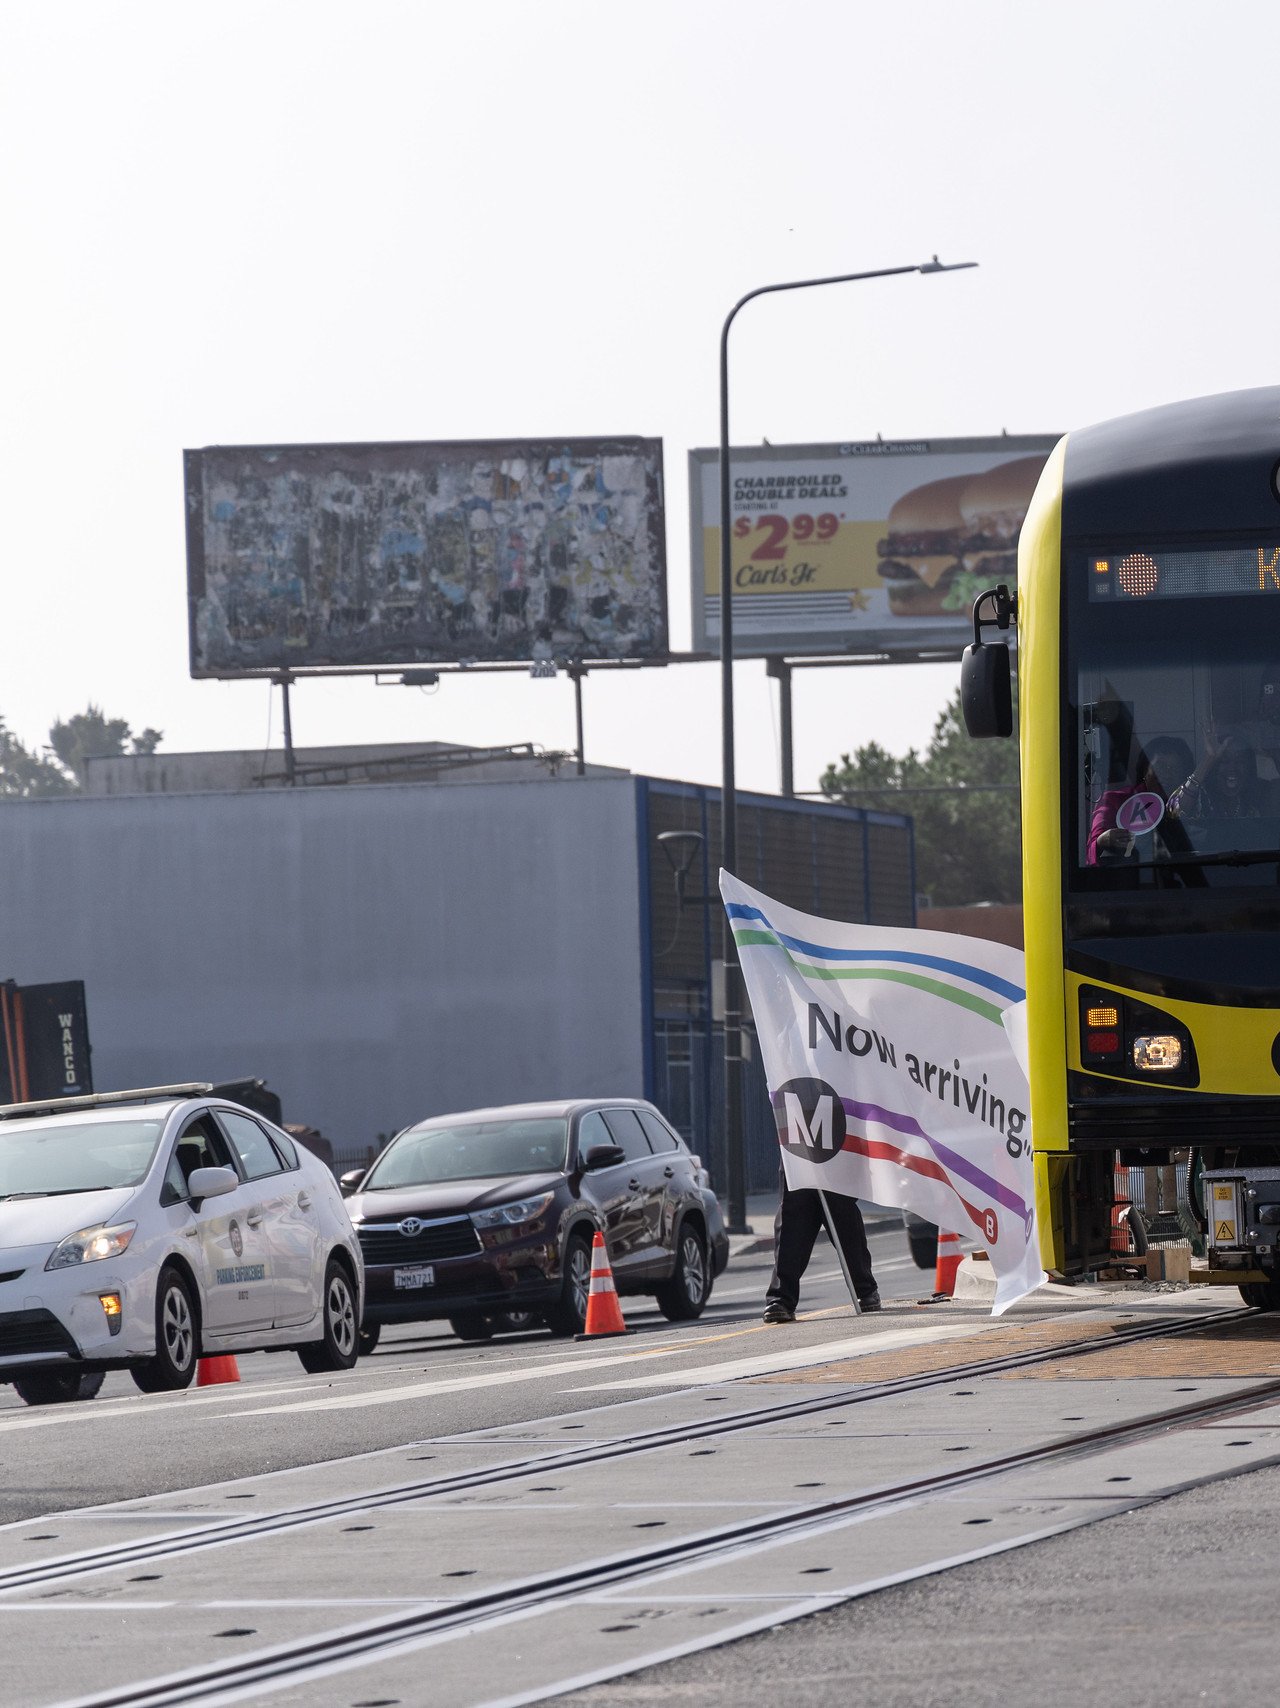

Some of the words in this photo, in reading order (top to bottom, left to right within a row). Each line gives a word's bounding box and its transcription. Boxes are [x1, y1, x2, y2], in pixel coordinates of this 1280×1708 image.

[734, 474, 842, 489] CHARBROILED
[734, 487, 795, 501] DOUBLE
[798, 486, 848, 499] DEALS
[736, 564, 788, 587] Carl's
[1130, 801, 1154, 823] K
[808, 1003, 897, 1069] Now
[58, 1013, 76, 1084] WANCO
[783, 1093, 834, 1150] M
[985, 1214, 994, 1238] B
[216, 1268, 235, 1285] PARKING
[235, 1264, 265, 1283] ENFORCEMENT
